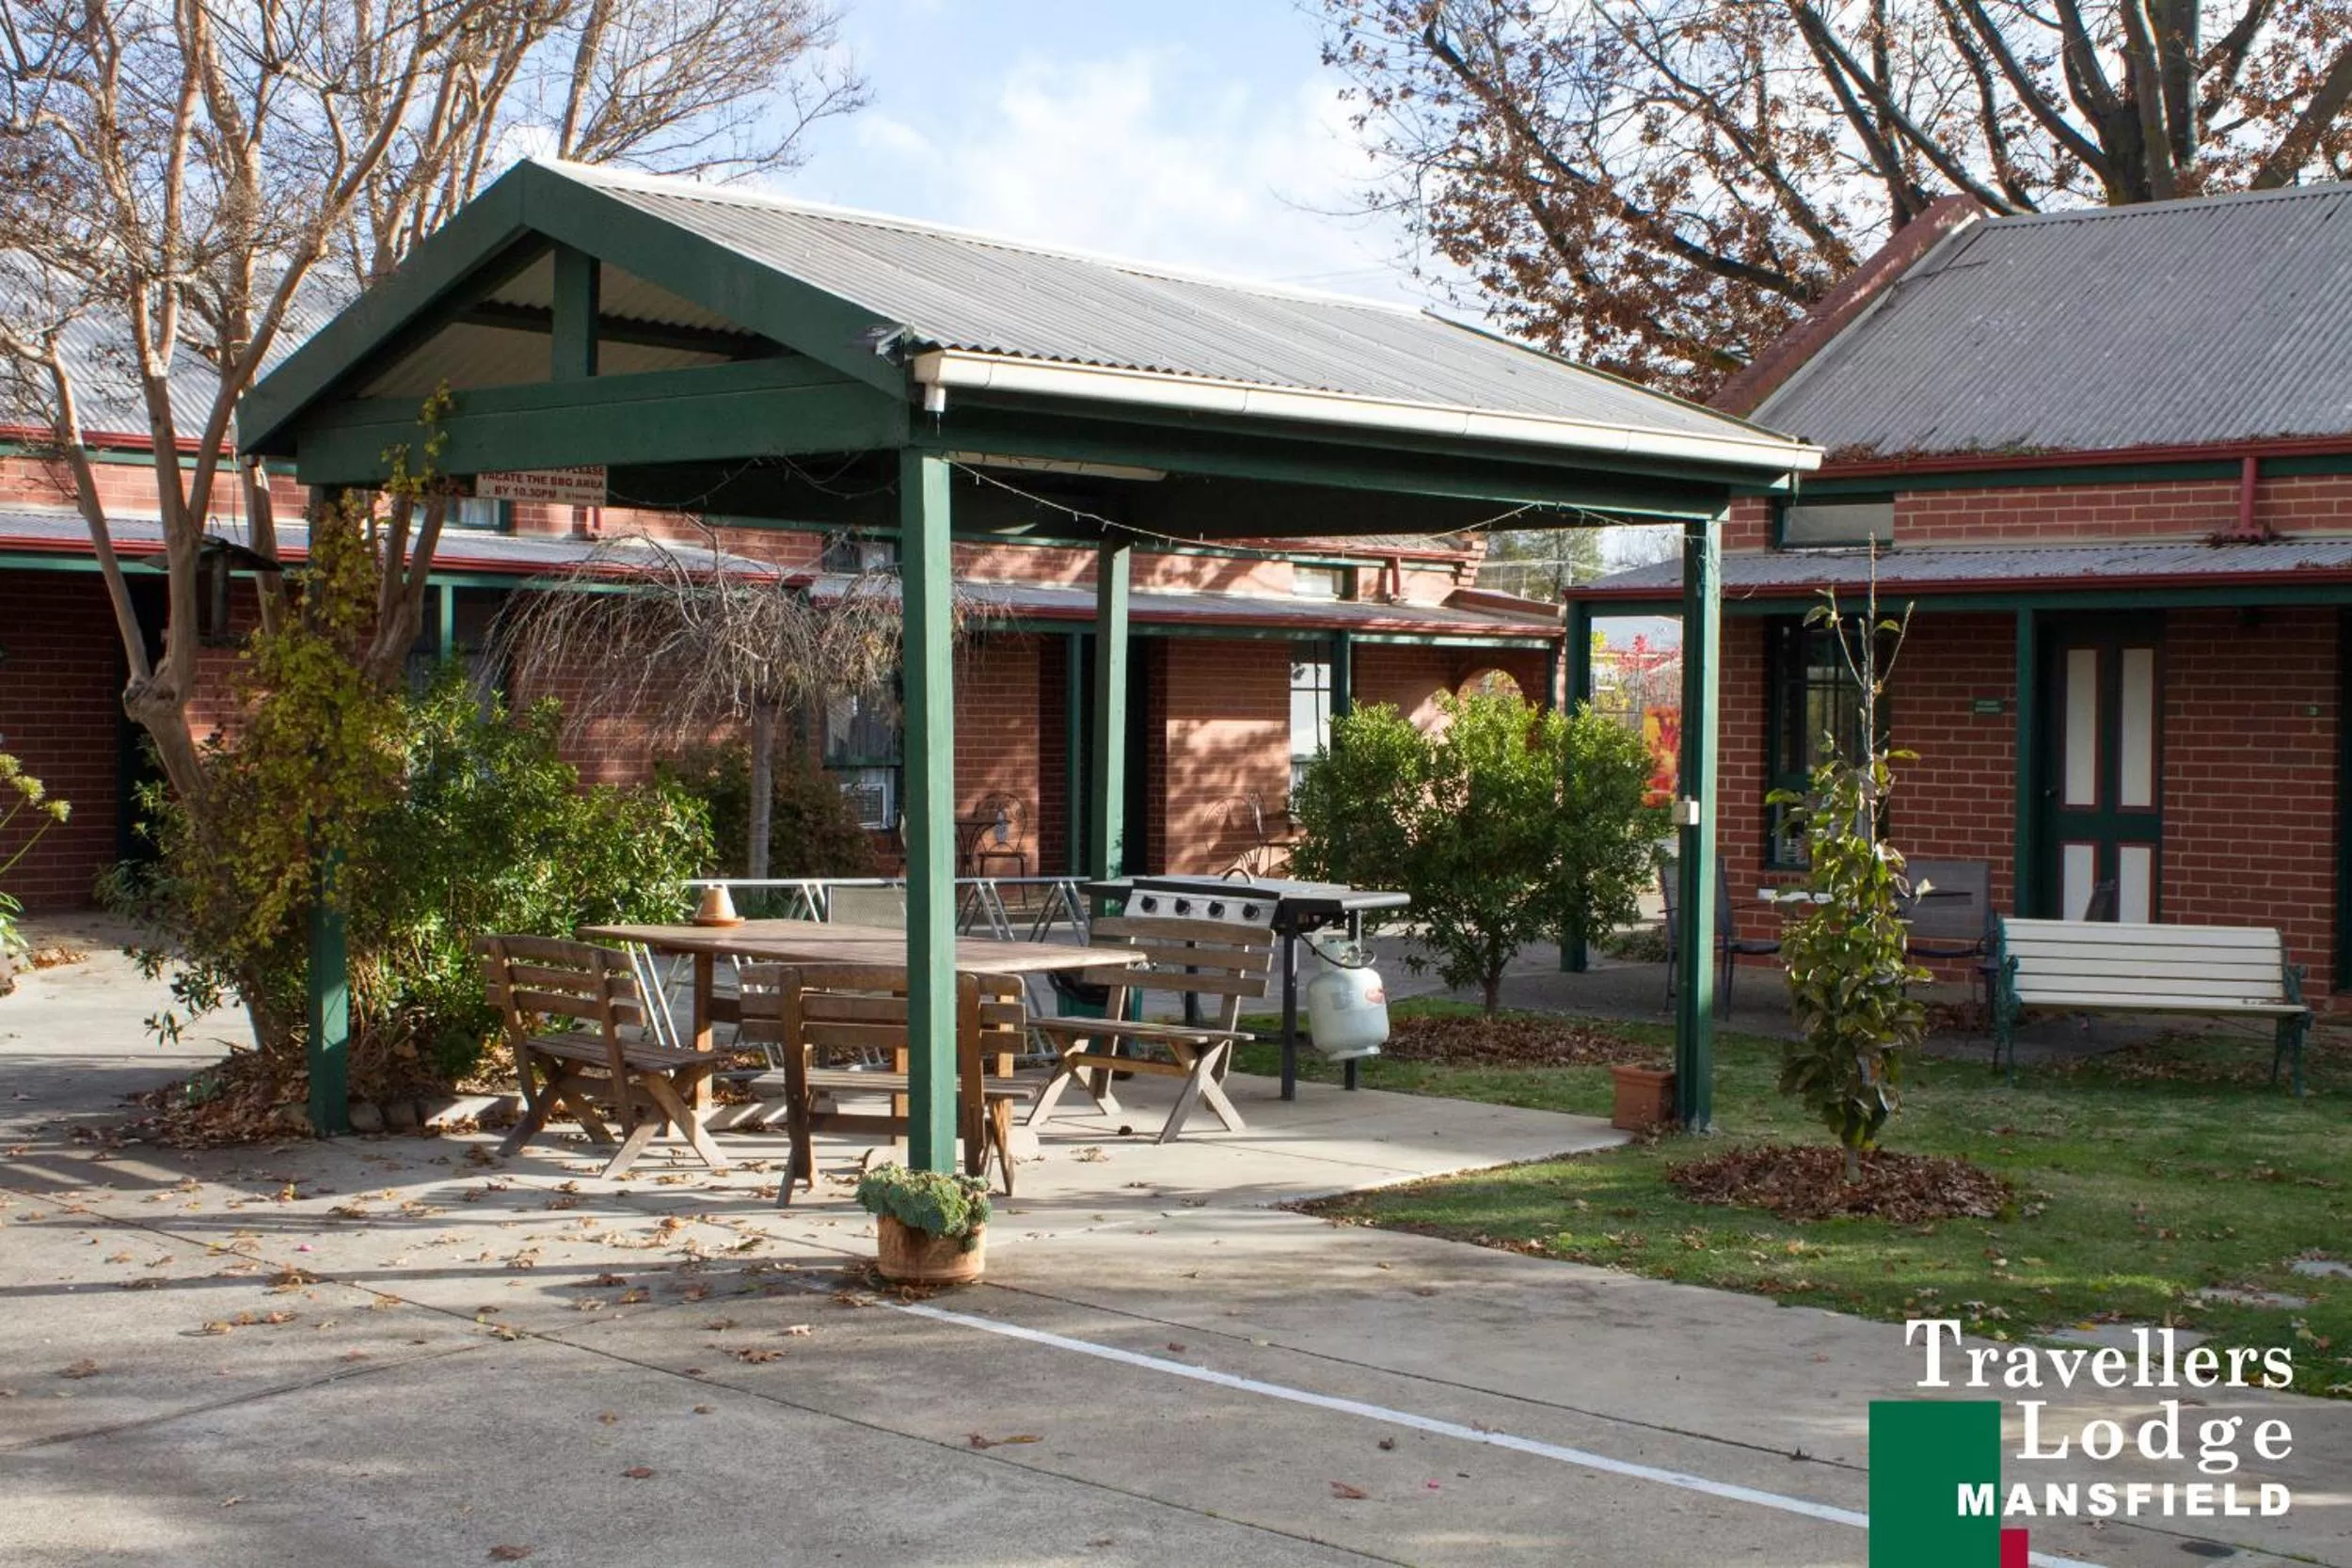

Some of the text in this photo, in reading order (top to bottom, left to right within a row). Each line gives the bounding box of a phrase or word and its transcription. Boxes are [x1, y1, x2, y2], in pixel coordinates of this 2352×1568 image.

[481, 472, 603, 489] VACATE THE BBQ AREA
[494, 485, 509, 496] BY
